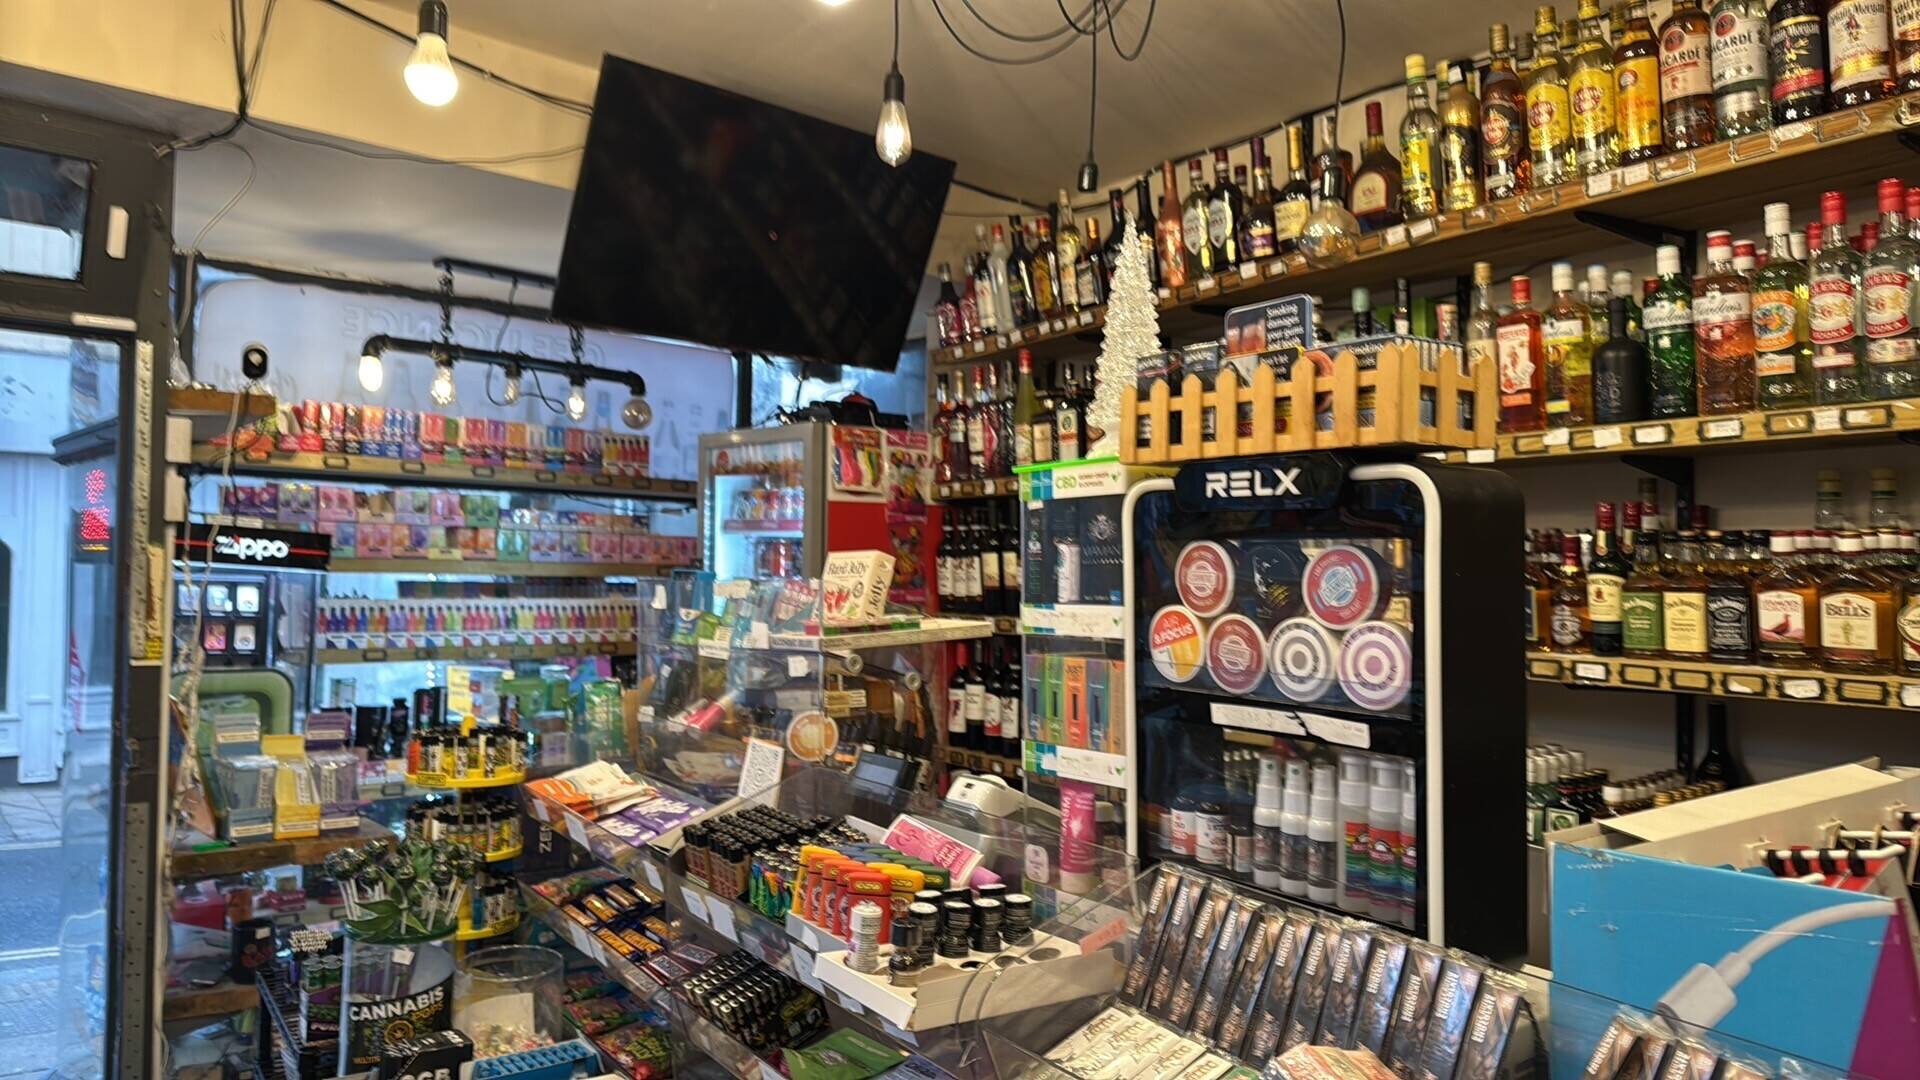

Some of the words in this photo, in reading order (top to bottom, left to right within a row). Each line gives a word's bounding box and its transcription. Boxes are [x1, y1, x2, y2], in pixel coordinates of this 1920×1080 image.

[1711, 30, 1753, 53] ACARDÍ
[1661, 45, 1701, 67] ACARDÍ
[1055, 475, 1078, 489] CBD
[1205, 467, 1302, 498] RELX
[1825, 604, 1872, 618] BELL'S
[349, 985, 445, 1022] CANNABIS
